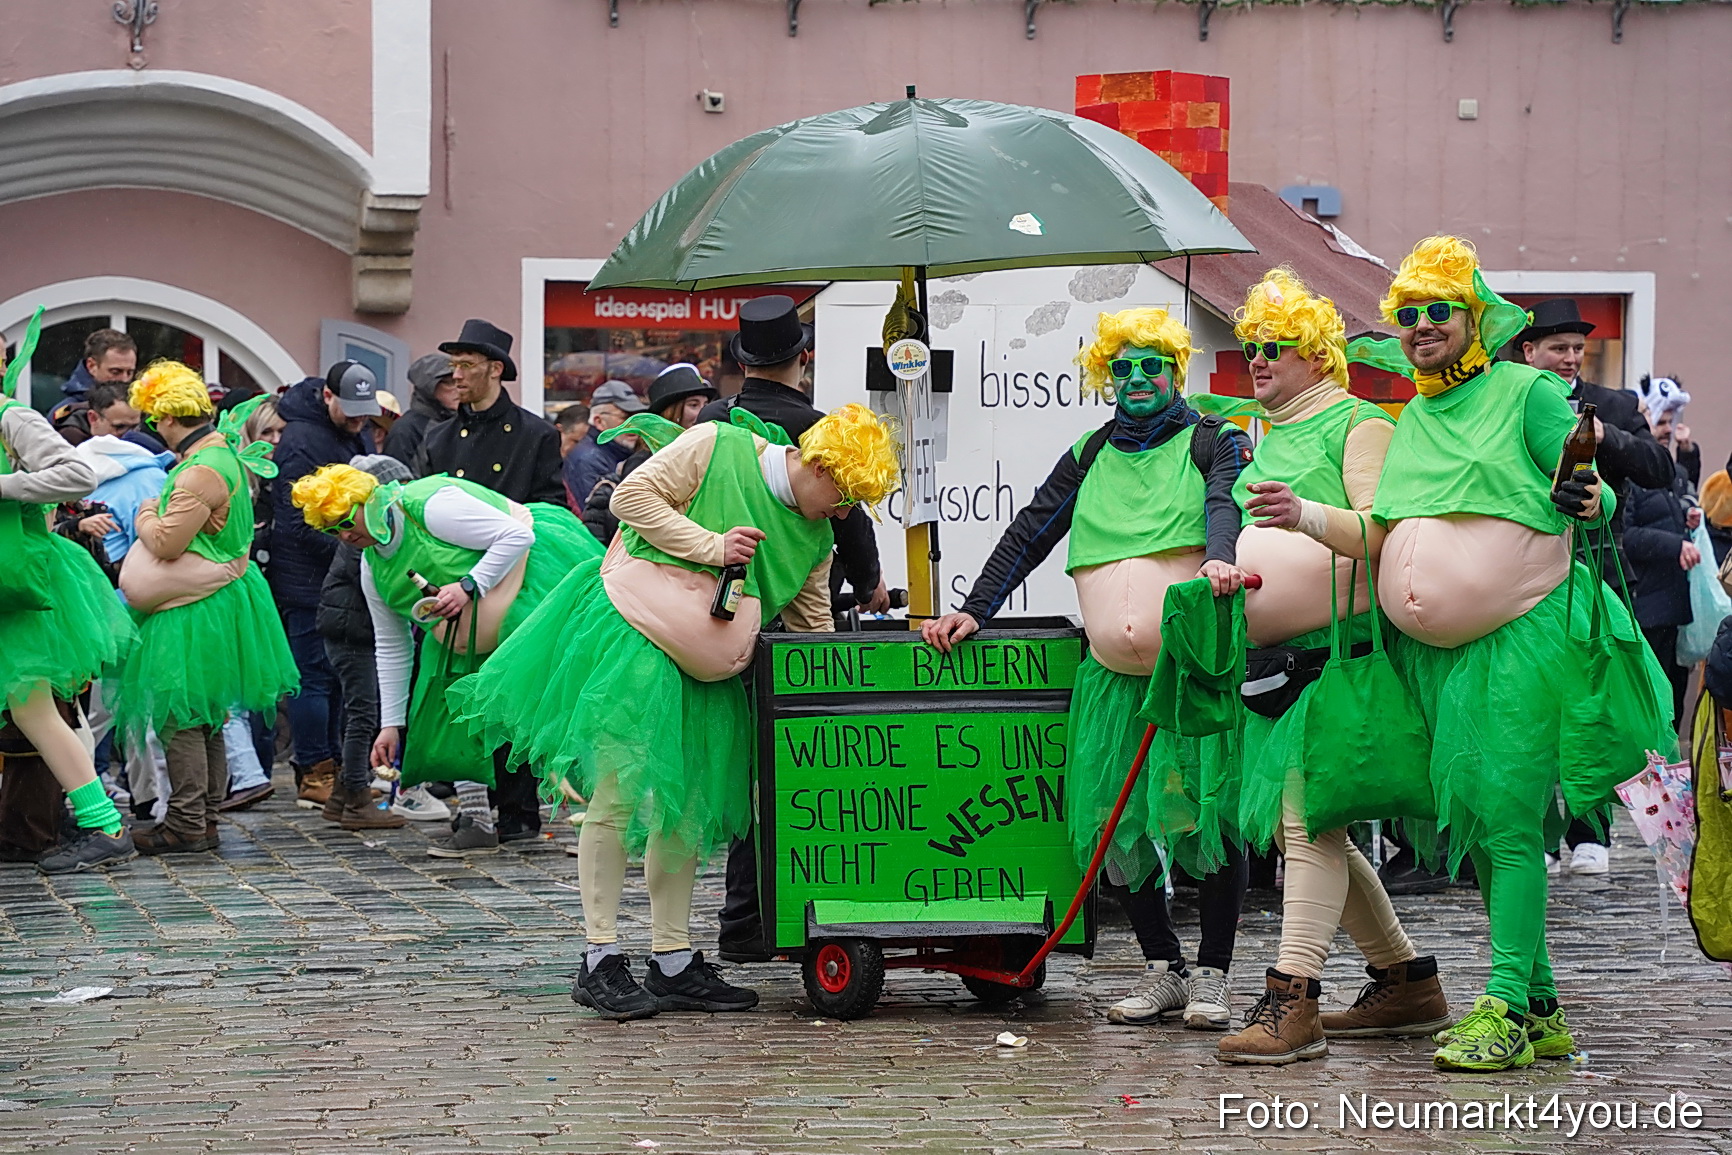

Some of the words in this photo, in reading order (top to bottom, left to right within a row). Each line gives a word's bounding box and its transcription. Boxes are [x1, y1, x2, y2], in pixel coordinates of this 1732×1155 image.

[594, 295, 691, 323] idee+spiel
[785, 646, 877, 687] OHNE
[913, 644, 1049, 687] BAUERN
[784, 719, 907, 769] WÜRDE
[935, 724, 981, 769] ES
[1000, 723, 1067, 771] UNS
[789, 781, 929, 833] SCHÖNE
[927, 774, 1065, 858] WESEN
[790, 842, 889, 885] NICHT
[904, 867, 1024, 907] GEBEN
